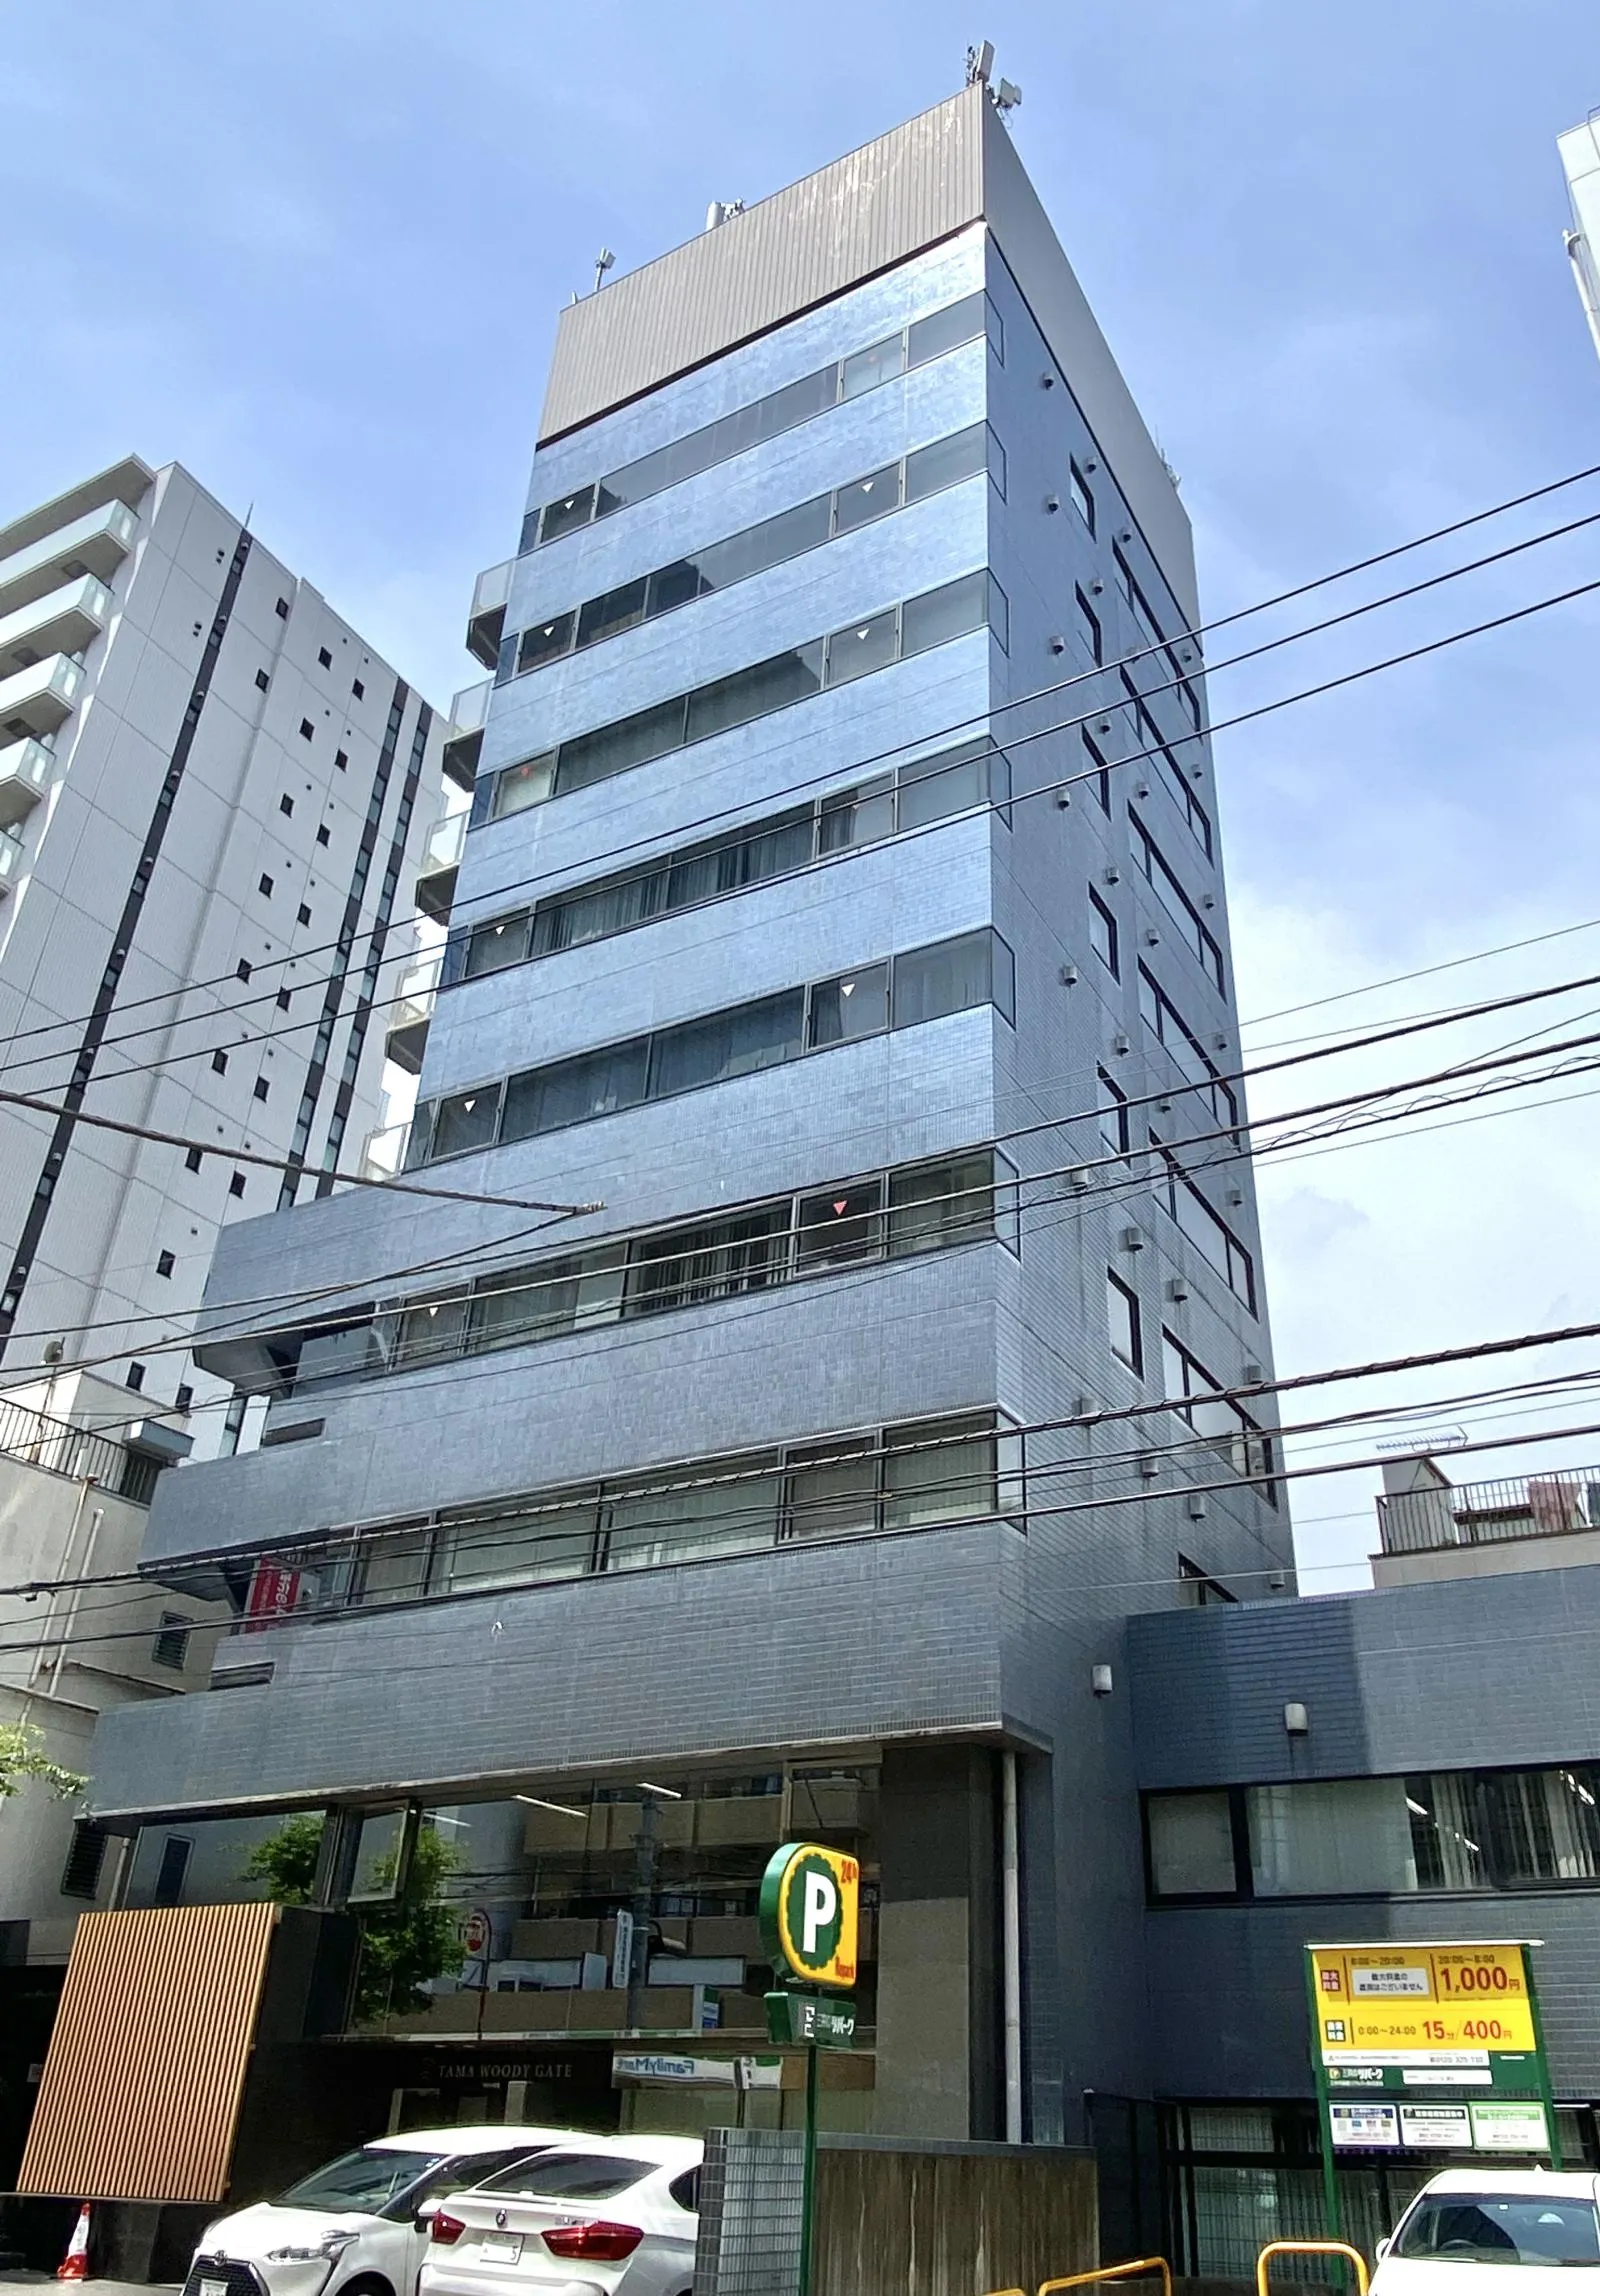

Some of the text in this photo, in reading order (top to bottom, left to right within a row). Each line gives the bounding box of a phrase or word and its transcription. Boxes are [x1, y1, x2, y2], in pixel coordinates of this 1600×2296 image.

[803, 1870, 837, 1954] P
[439, 2063, 573, 2079] TAMA WOODY GATE
